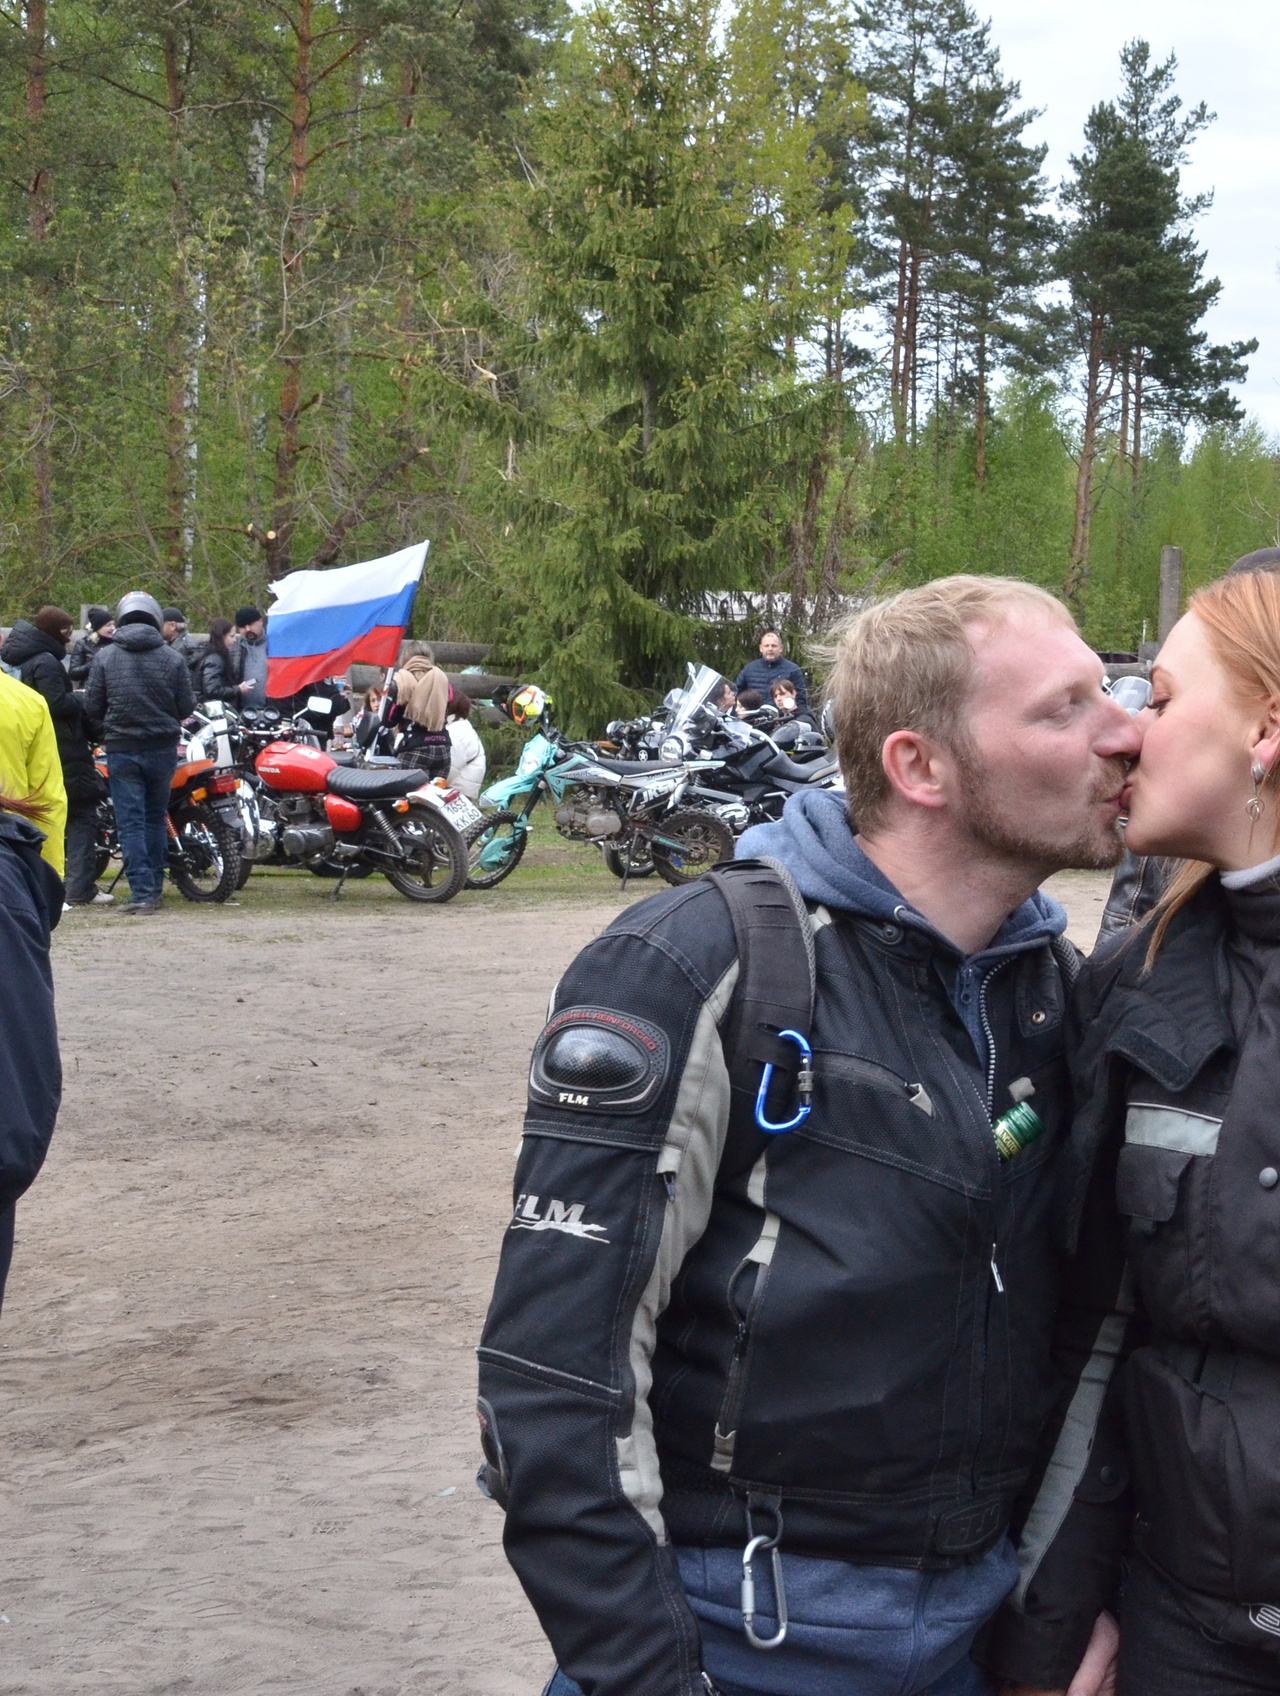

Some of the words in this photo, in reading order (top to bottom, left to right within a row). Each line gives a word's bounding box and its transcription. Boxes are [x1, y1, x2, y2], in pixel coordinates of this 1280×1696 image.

[258, 766, 281, 774] HONDA
[593, 1012, 656, 1051] REINFORCED
[559, 1092, 589, 1106] FLM
